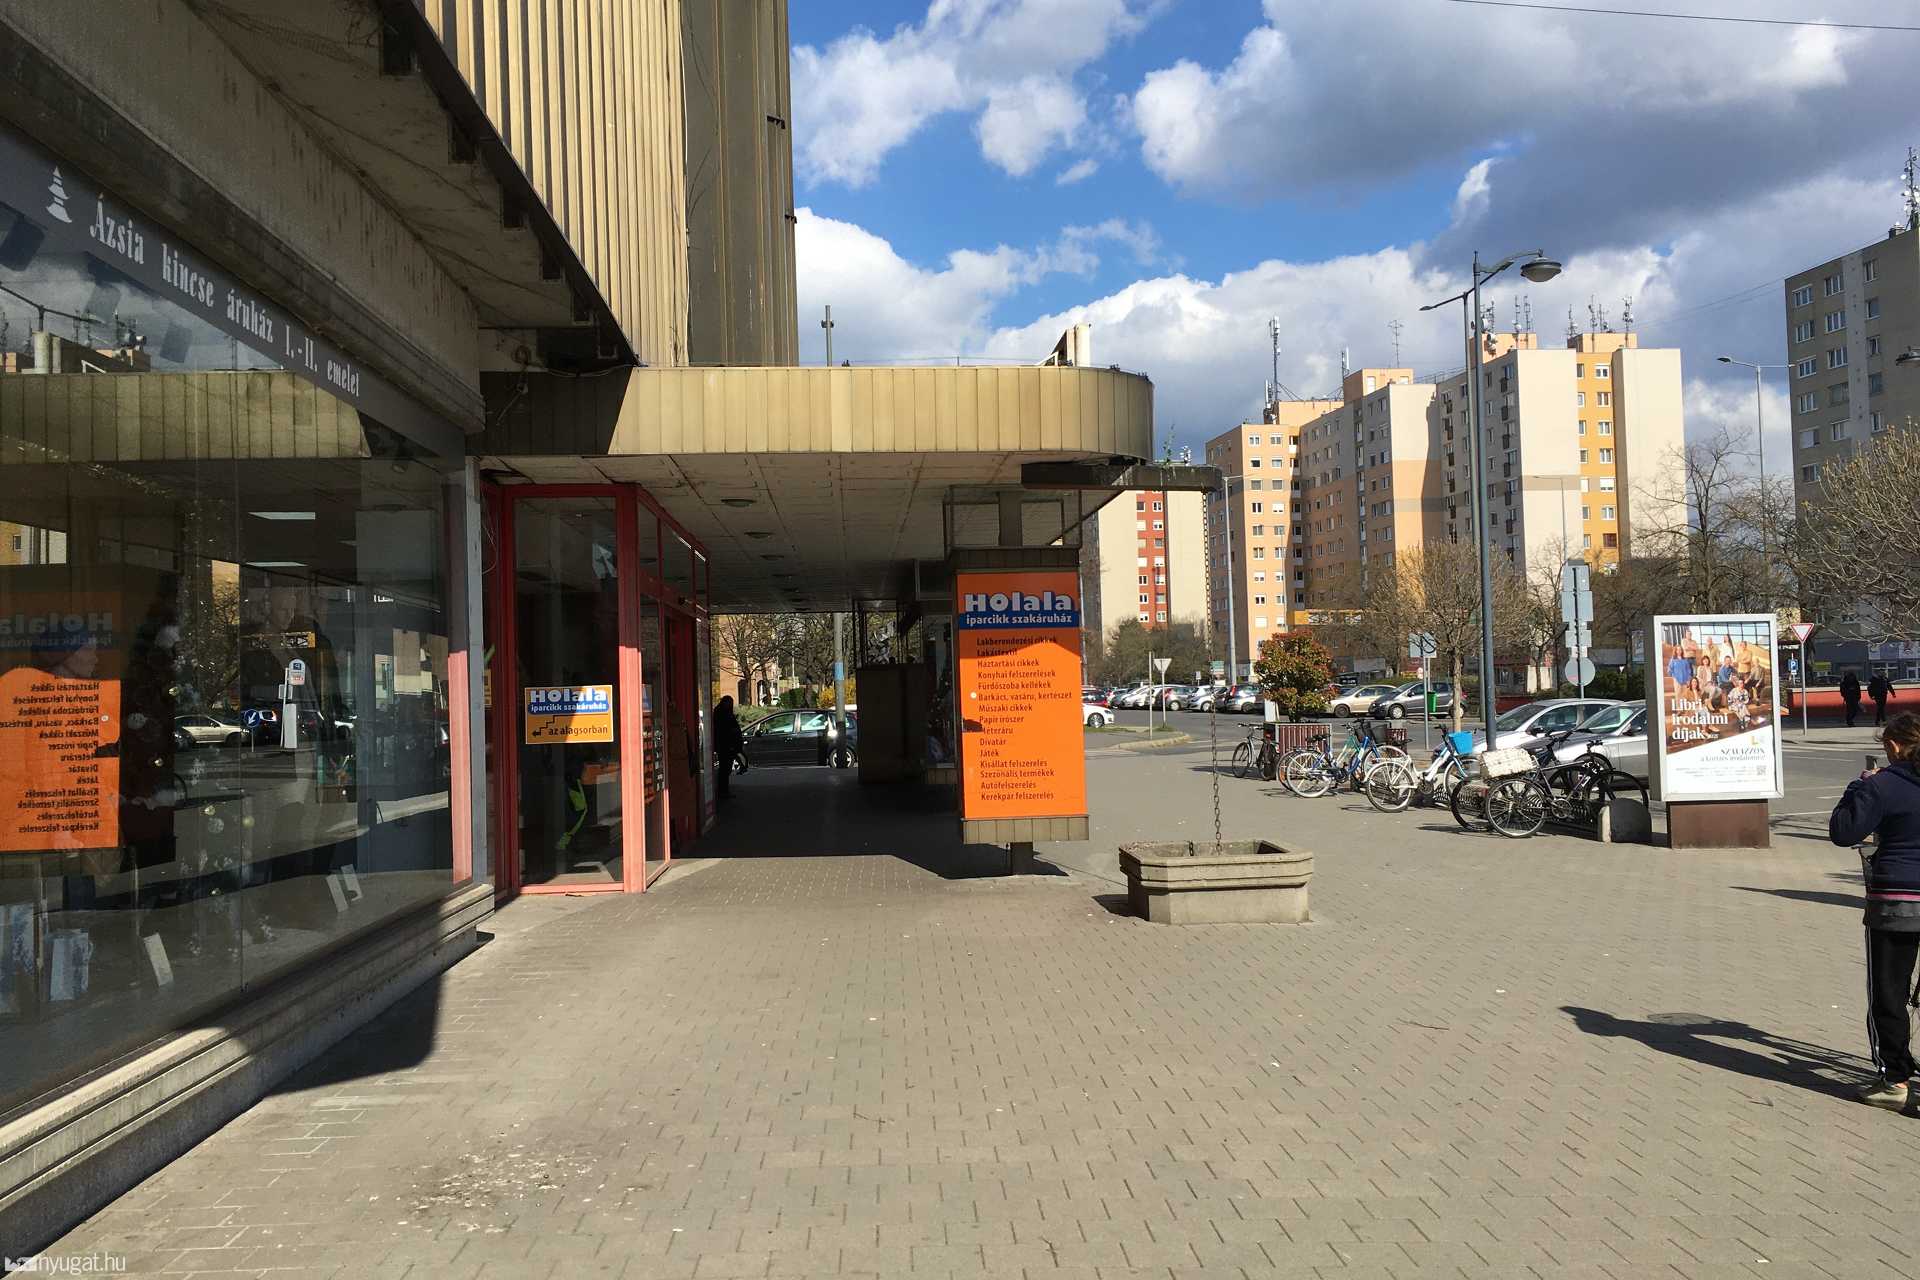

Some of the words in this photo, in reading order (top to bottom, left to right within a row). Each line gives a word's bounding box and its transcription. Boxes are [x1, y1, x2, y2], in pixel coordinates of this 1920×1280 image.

[90, 193, 144, 264] Ázsia
[162, 243, 214, 307] kincse
[227, 289, 273, 343] áruház
[966, 614, 1009, 626] iparcikk
[1012, 614, 1072, 624] szakáruház
[531, 704, 561, 712] iparcikk
[564, 702, 606, 711] szakáruház
[1672, 699, 1702, 711] Libri
[1672, 712, 1728, 724] irodalmi
[560, 725, 608, 736] alagsorban
[1672, 727, 1705, 742] díjak
[980, 749, 999, 757] Játék
[980, 760, 1007, 768] Kisállat
[1020, 769, 1054, 777] termékek
